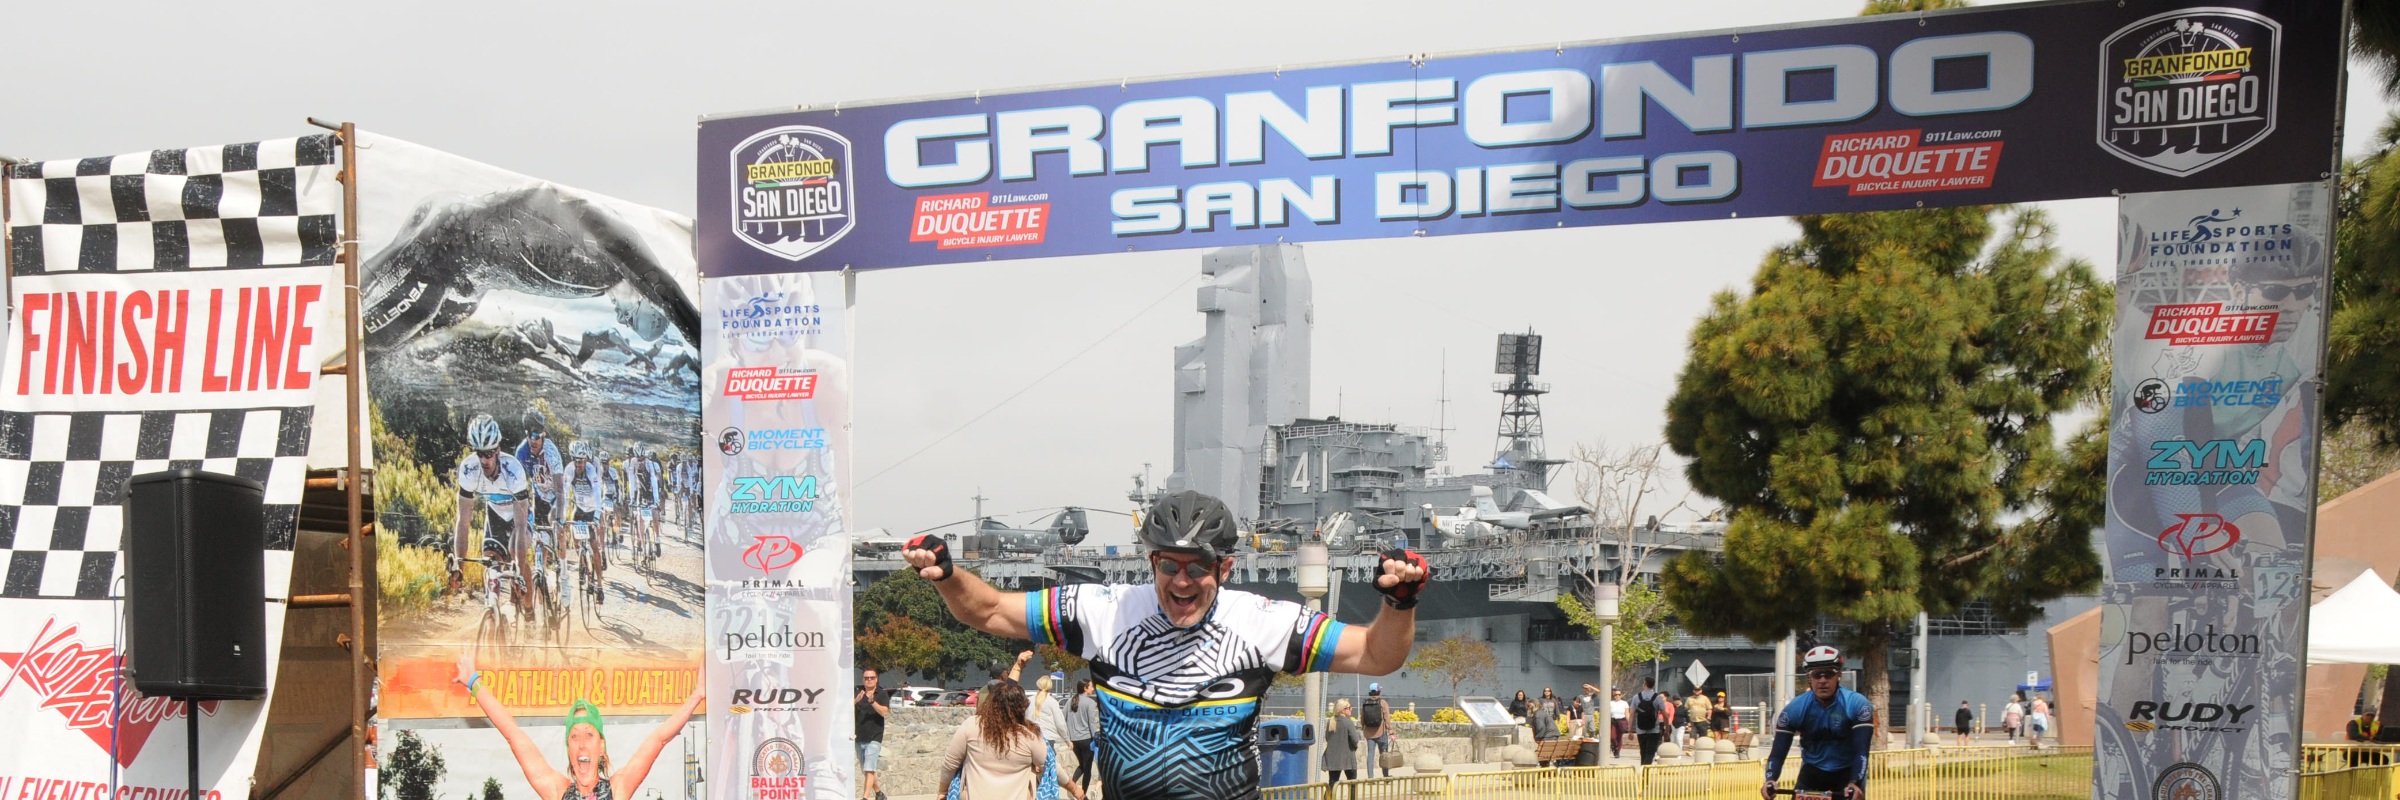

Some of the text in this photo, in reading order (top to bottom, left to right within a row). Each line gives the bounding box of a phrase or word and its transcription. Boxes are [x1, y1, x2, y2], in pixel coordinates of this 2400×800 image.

[2128, 50, 2247, 76] GRANFONDO
[2115, 76, 2259, 124] SAN DIEGO
[884, 30, 2034, 189] GRANFONDO
[1829, 135, 1910, 152] RICHARD
[1925, 129, 2002, 143] 911Law.com
[750, 162, 831, 180] GRANFONDO
[1822, 147, 1992, 179] DUQUETTE
[1856, 176, 1985, 192] BICYCLE INJURY LAWYER
[743, 181, 842, 218] SAN DIEGO
[991, 192, 1048, 204] 911Law.com
[1111, 150, 1742, 237] SAN DIEGO
[921, 196, 981, 212] RICHARD
[917, 207, 1041, 236] DUQUETTE
[943, 232, 1038, 246] BICYCLE INJURY LAWYER
[2152, 224, 2292, 242] LIFE SPORTS
[2151, 239, 2292, 256] FOUNDATION
[2150, 255, 2291, 268] LIFE THROUGH SPORTS
[723, 304, 820, 318] LIFE SPORTS
[2158, 307, 2215, 317] RICHARD
[2225, 304, 2278, 312] 911Law.com
[723, 318, 821, 330] FOUNDATION
[2152, 316, 2271, 335] DUQUETTE
[17, 285, 322, 395] FINISH LINE
[732, 370, 772, 378] RICHARD
[728, 377, 812, 392] DUQUETTE
[2176, 380, 2284, 394] MOMENT
[2174, 394, 2282, 408] BICYCLES
[748, 428, 825, 440] MOMENT
[747, 440, 824, 450] BICYCLES
[2147, 439, 2266, 470] ZYM
[1290, 451, 1329, 494] 41
[2145, 470, 2259, 486] HYDRATION
[731, 476, 816, 500] ZYM
[730, 501, 813, 514] HYDRATION
[2156, 568, 2239, 578] PRIMAL
[742, 580, 804, 588] PRIMAL
[2154, 582, 2190, 590] CYCLING
[2200, 582, 2239, 590] APPAREL
[725, 624, 826, 660] peloton
[2125, 624, 2260, 665] peloton
[590, 669, 606, 704] &
[732, 688, 825, 704] RUDY
[1182, 705, 1238, 716] DIEGO
[2129, 700, 2254, 724] RUDY
[2158, 724, 2246, 734] PROJECT
[752, 777, 806, 788] BALLAST
[760, 789, 799, 800] POINT
